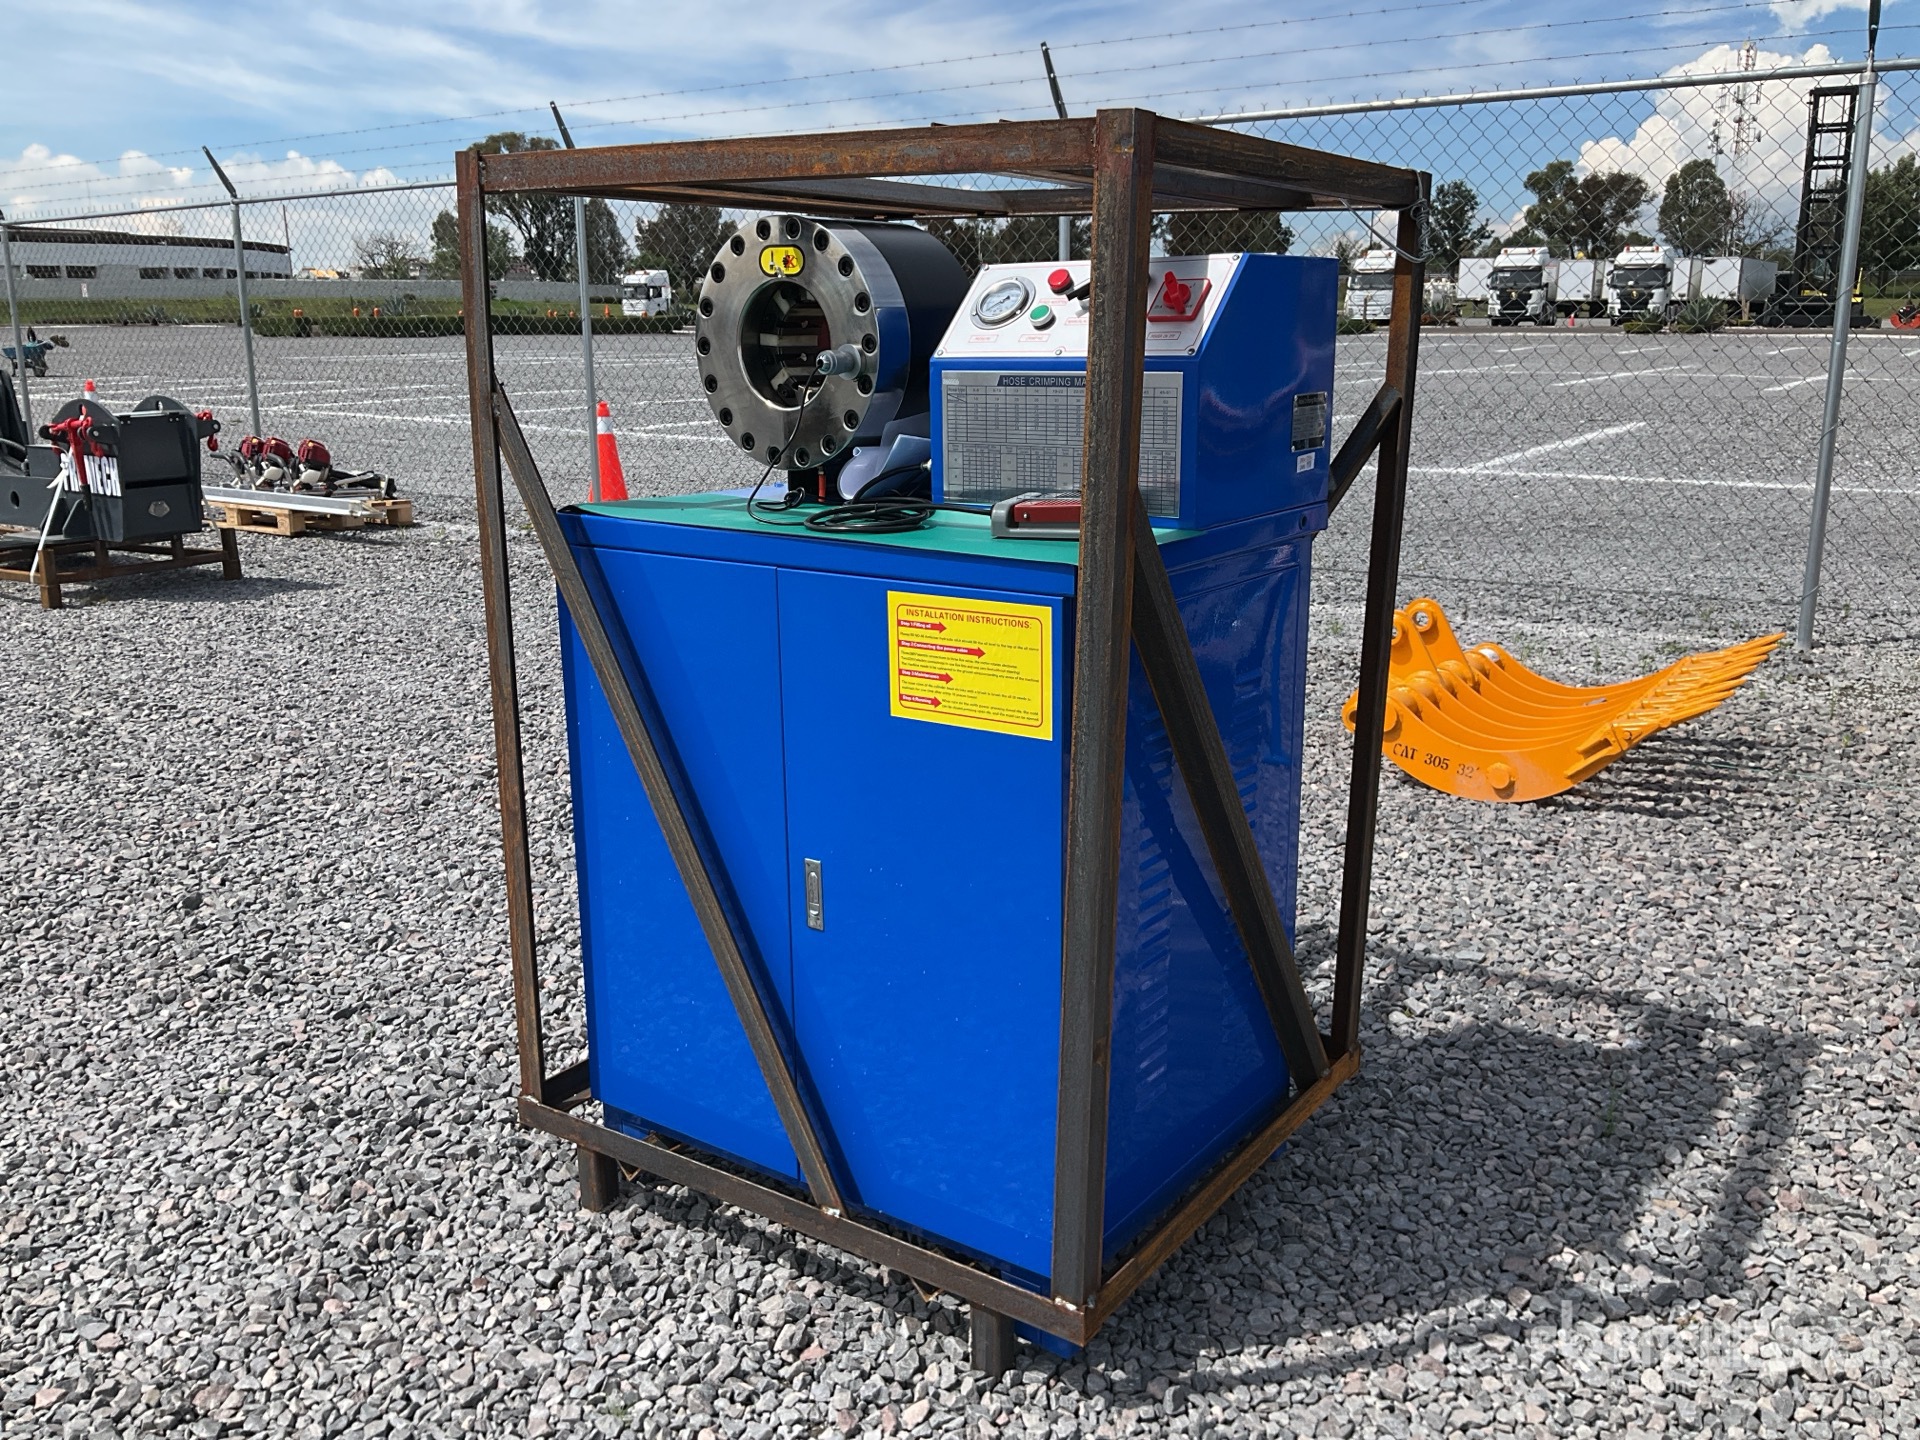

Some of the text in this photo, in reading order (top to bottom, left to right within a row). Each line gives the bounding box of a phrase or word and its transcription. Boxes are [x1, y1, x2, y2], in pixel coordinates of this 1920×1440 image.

[1002, 376, 1087, 387] HOSE CRIMPING MA
[906, 608, 1032, 629] INSTALLATION INSTRUCTIONS:
[1393, 744, 1418, 760] CAT
[1424, 753, 1450, 770] 305
